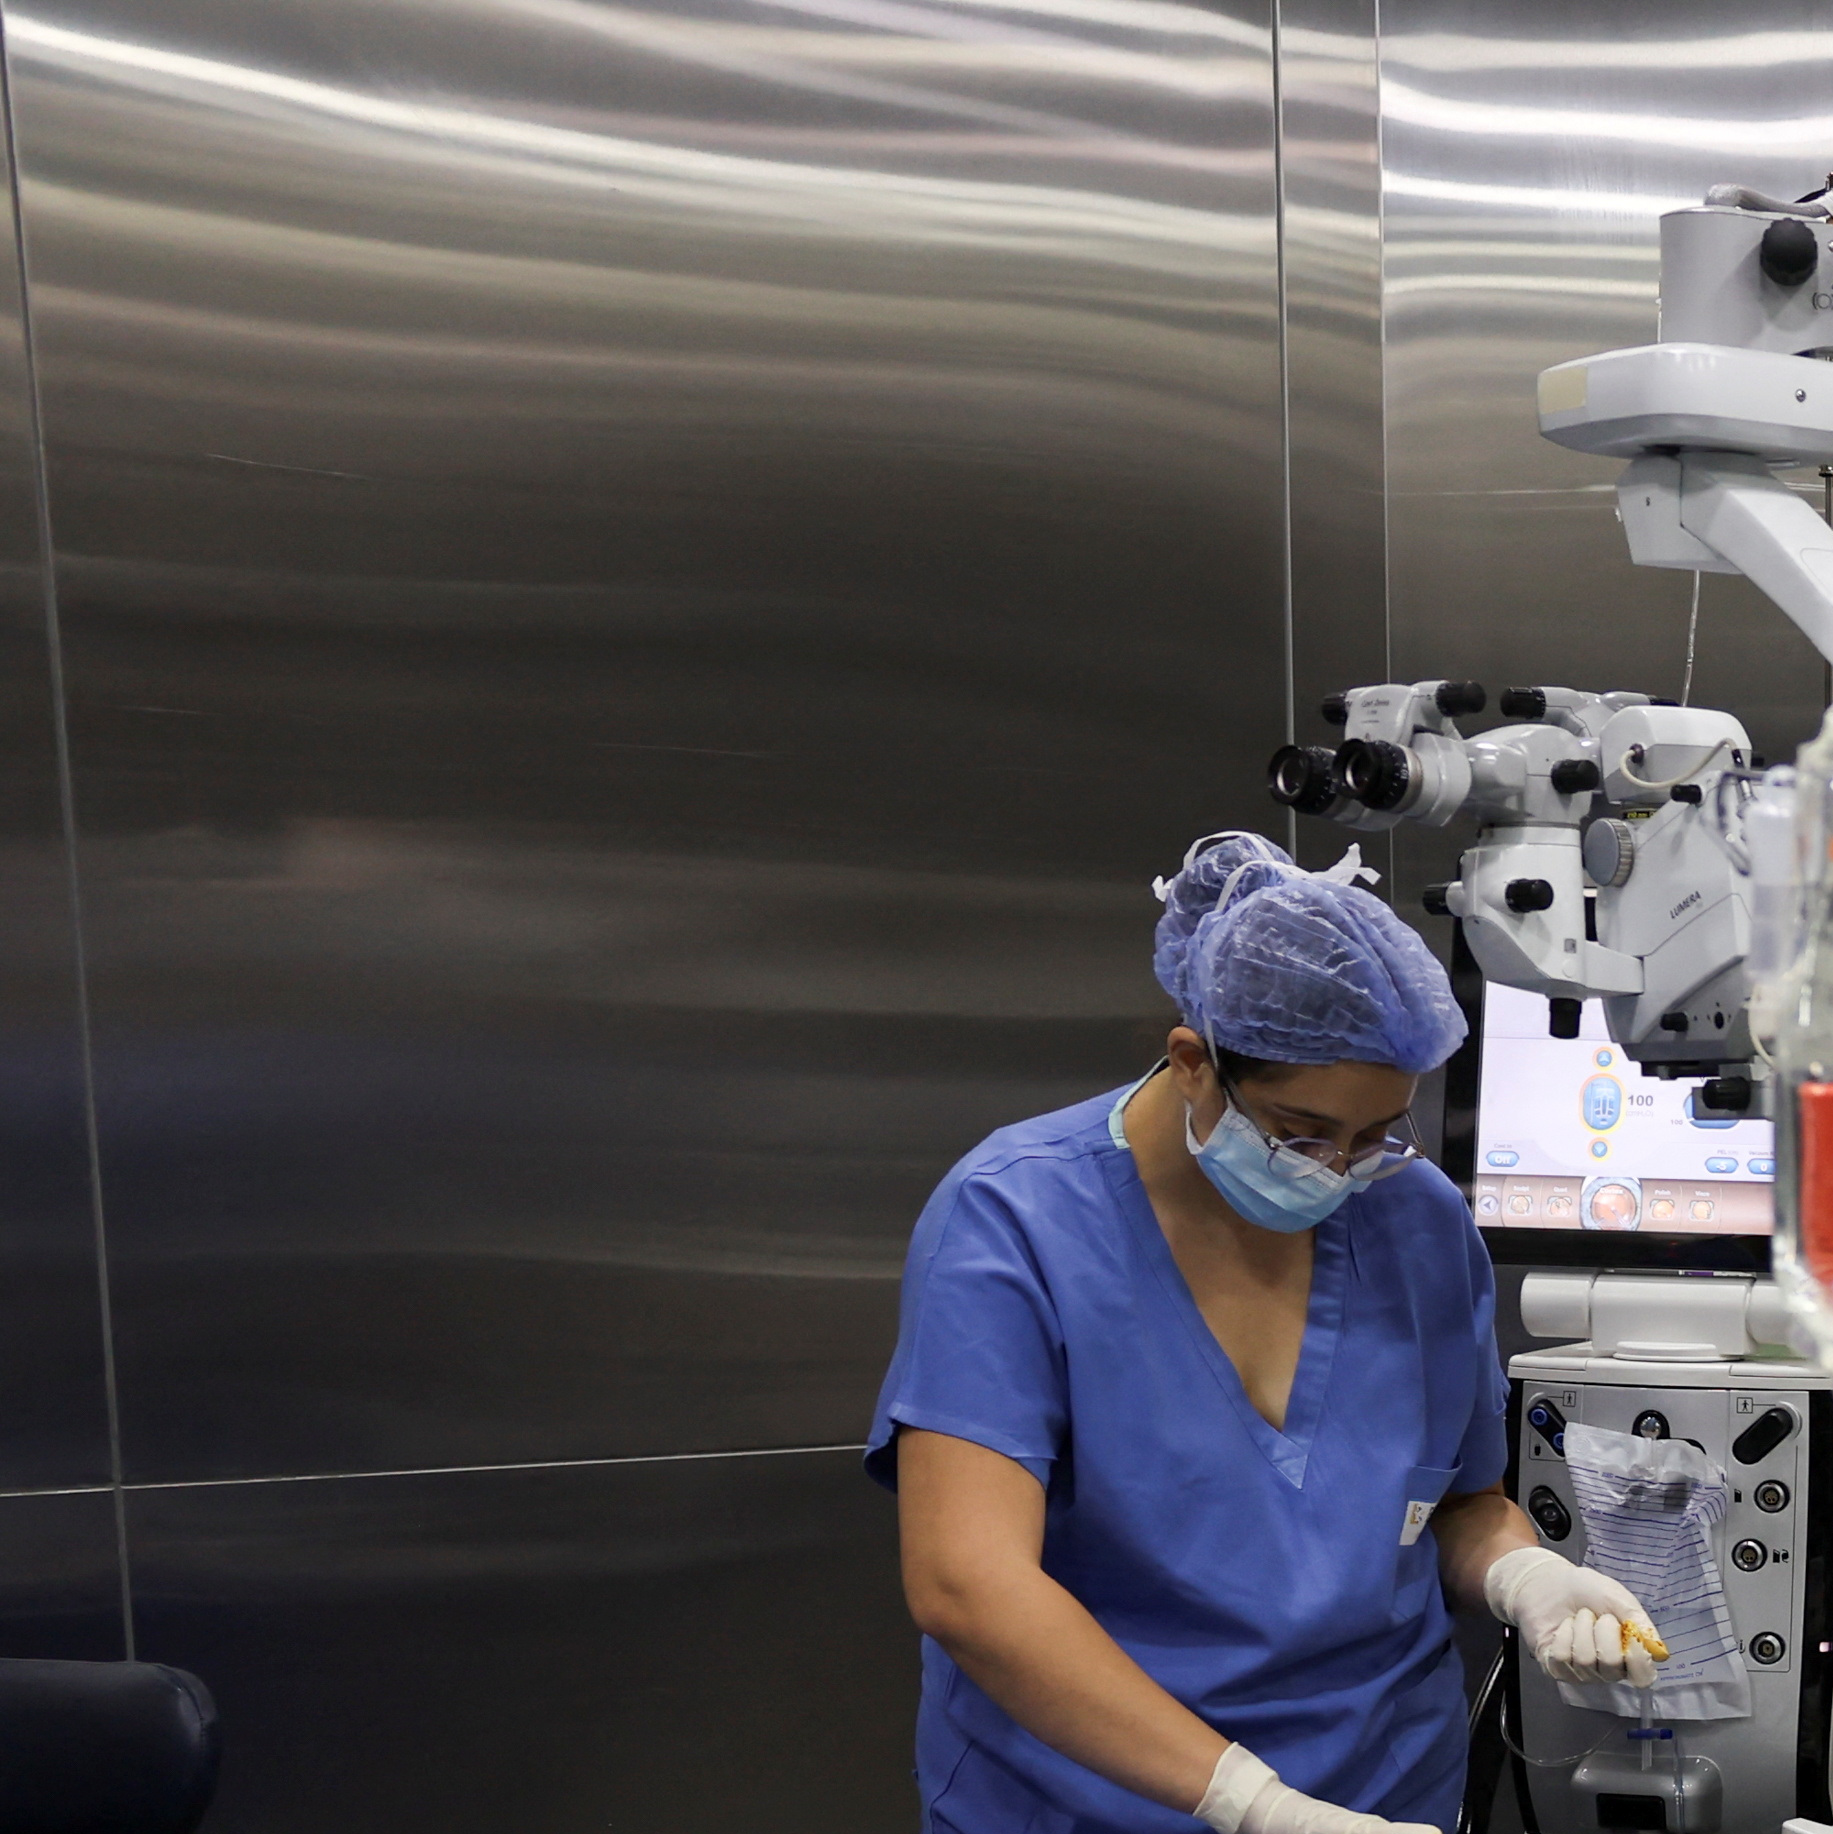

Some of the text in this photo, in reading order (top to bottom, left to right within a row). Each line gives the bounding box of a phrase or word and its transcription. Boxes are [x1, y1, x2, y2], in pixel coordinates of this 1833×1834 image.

[1670, 890, 1701, 919] LUMERA
[1628, 1095, 1654, 1106] 100
[1495, 1155, 1511, 1164] Off
